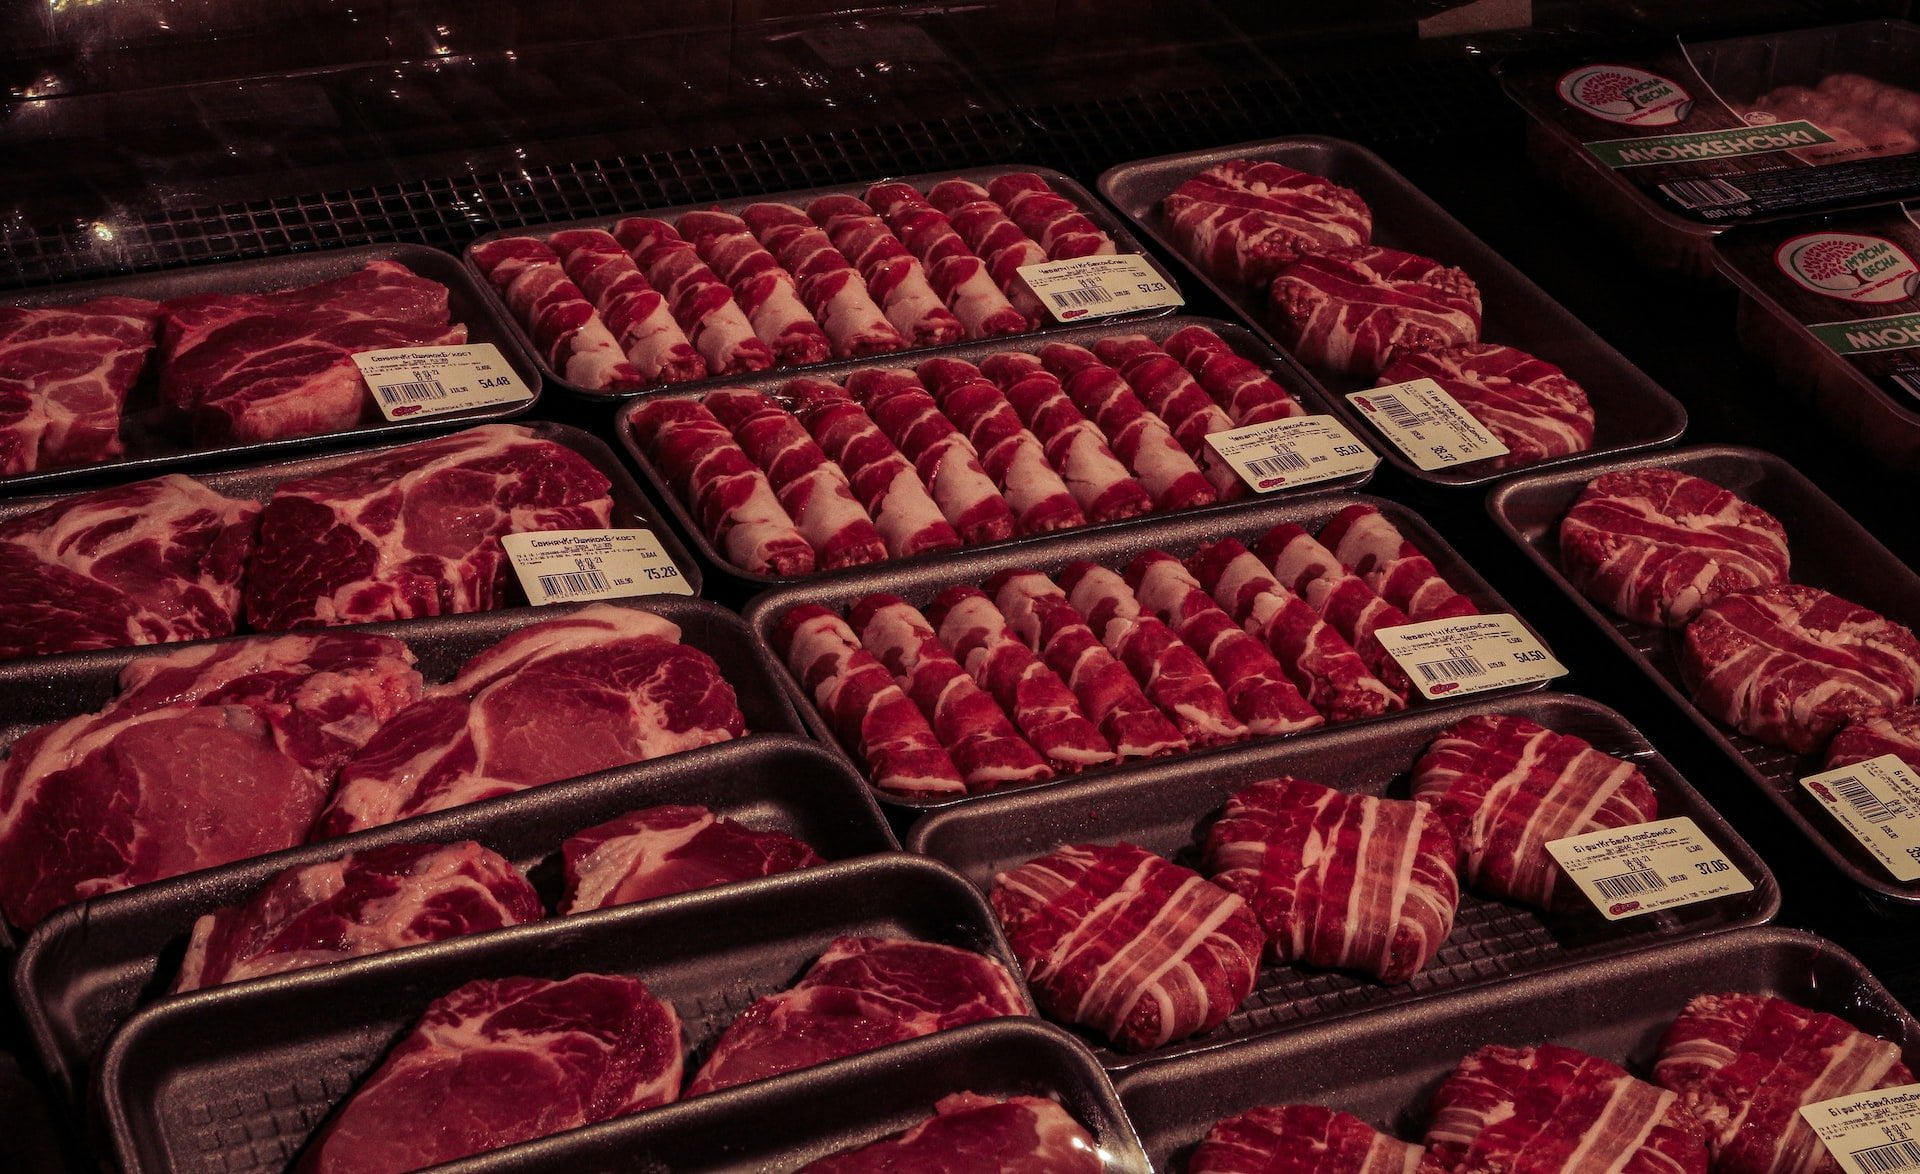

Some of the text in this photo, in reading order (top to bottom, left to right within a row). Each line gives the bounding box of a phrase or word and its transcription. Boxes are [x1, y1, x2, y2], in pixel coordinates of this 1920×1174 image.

[1638, 86, 1673, 104] ВЕСНА
[1618, 130, 1816, 162] МЮНХЕНСЬКІ
[1846, 243, 1890, 268] М'ЯСНА
[1862, 255, 1899, 277] ВЕСНА
[478, 377, 510, 390] 54.48
[1334, 445, 1364, 457] 55.81
[644, 566, 678, 580] 75.28
[1513, 651, 1546, 663] 54.50
[1695, 859, 1730, 875] 37.06
